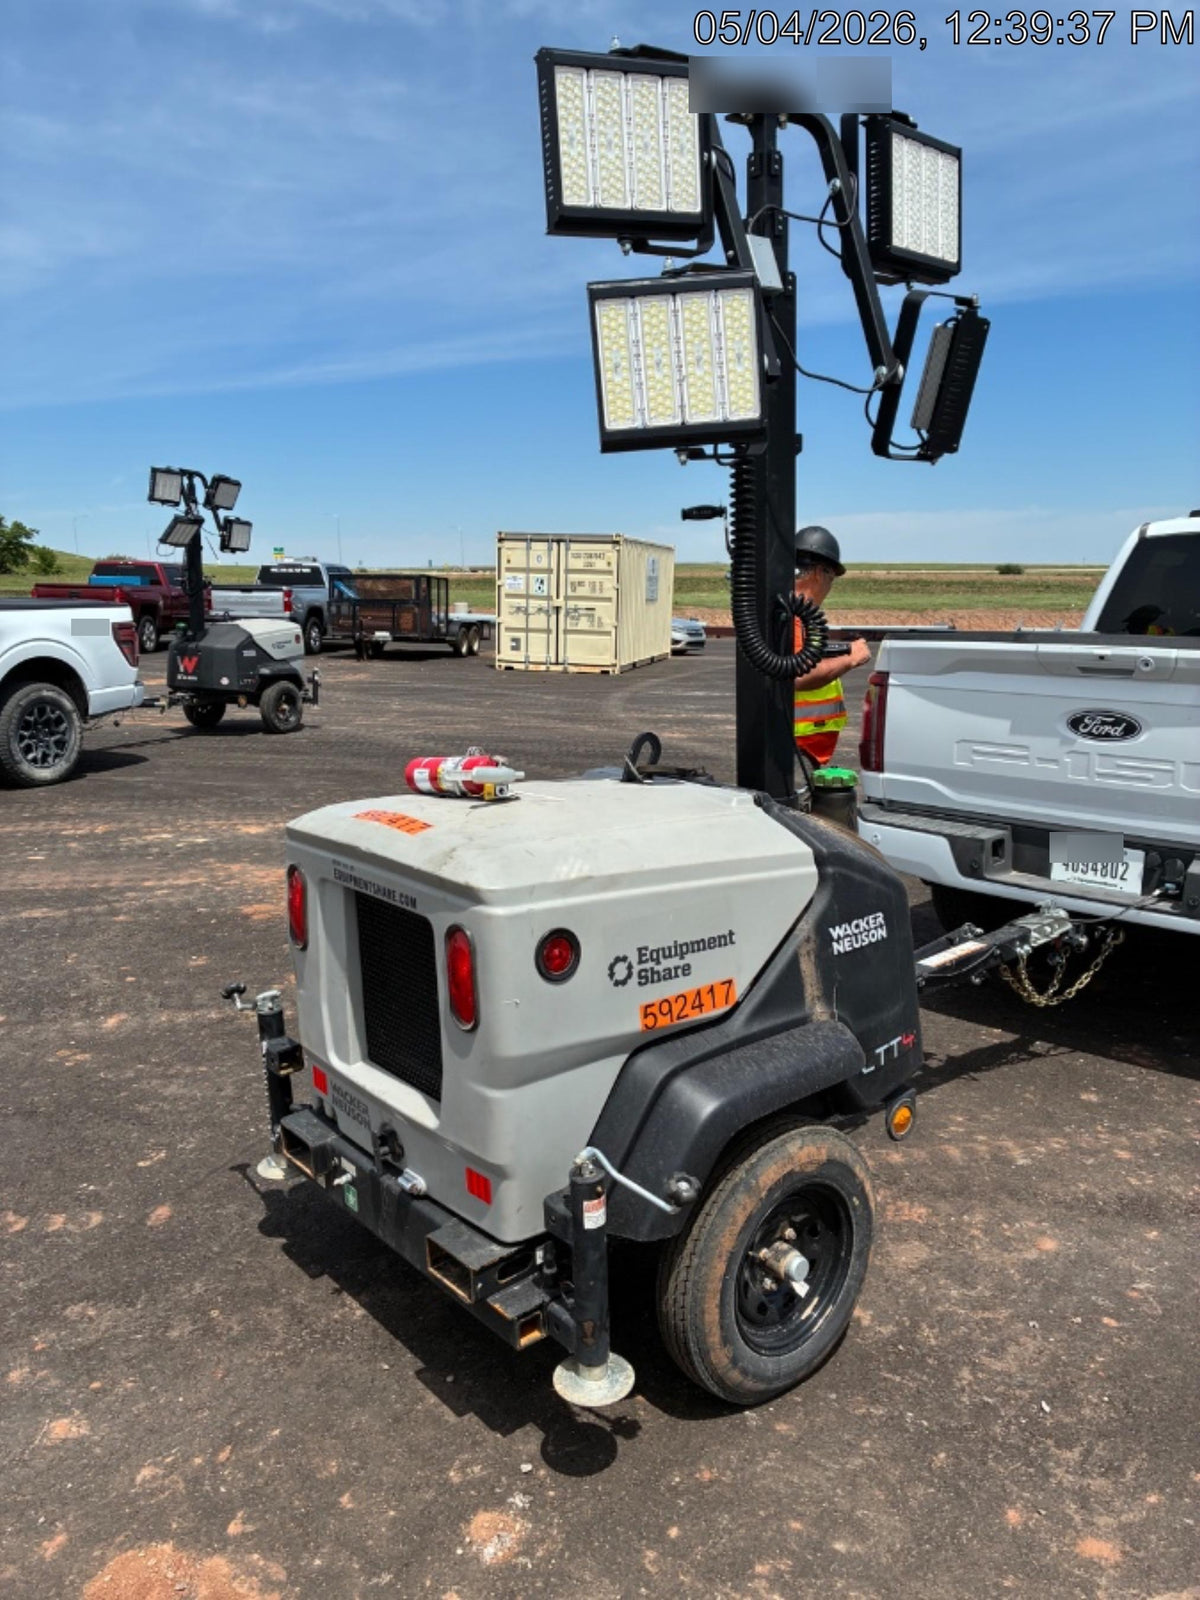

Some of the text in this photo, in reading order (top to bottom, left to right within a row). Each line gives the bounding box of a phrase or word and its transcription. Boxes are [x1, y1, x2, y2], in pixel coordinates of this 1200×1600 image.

[1078, 713, 1126, 739] Ford
[952, 739, 1200, 794] F-15
[828, 911, 886, 940] WACKER
[831, 925, 888, 956] NEUSON
[636, 929, 736, 966] Equipment
[637, 962, 692, 987] Share
[642, 978, 734, 1030] 592417
